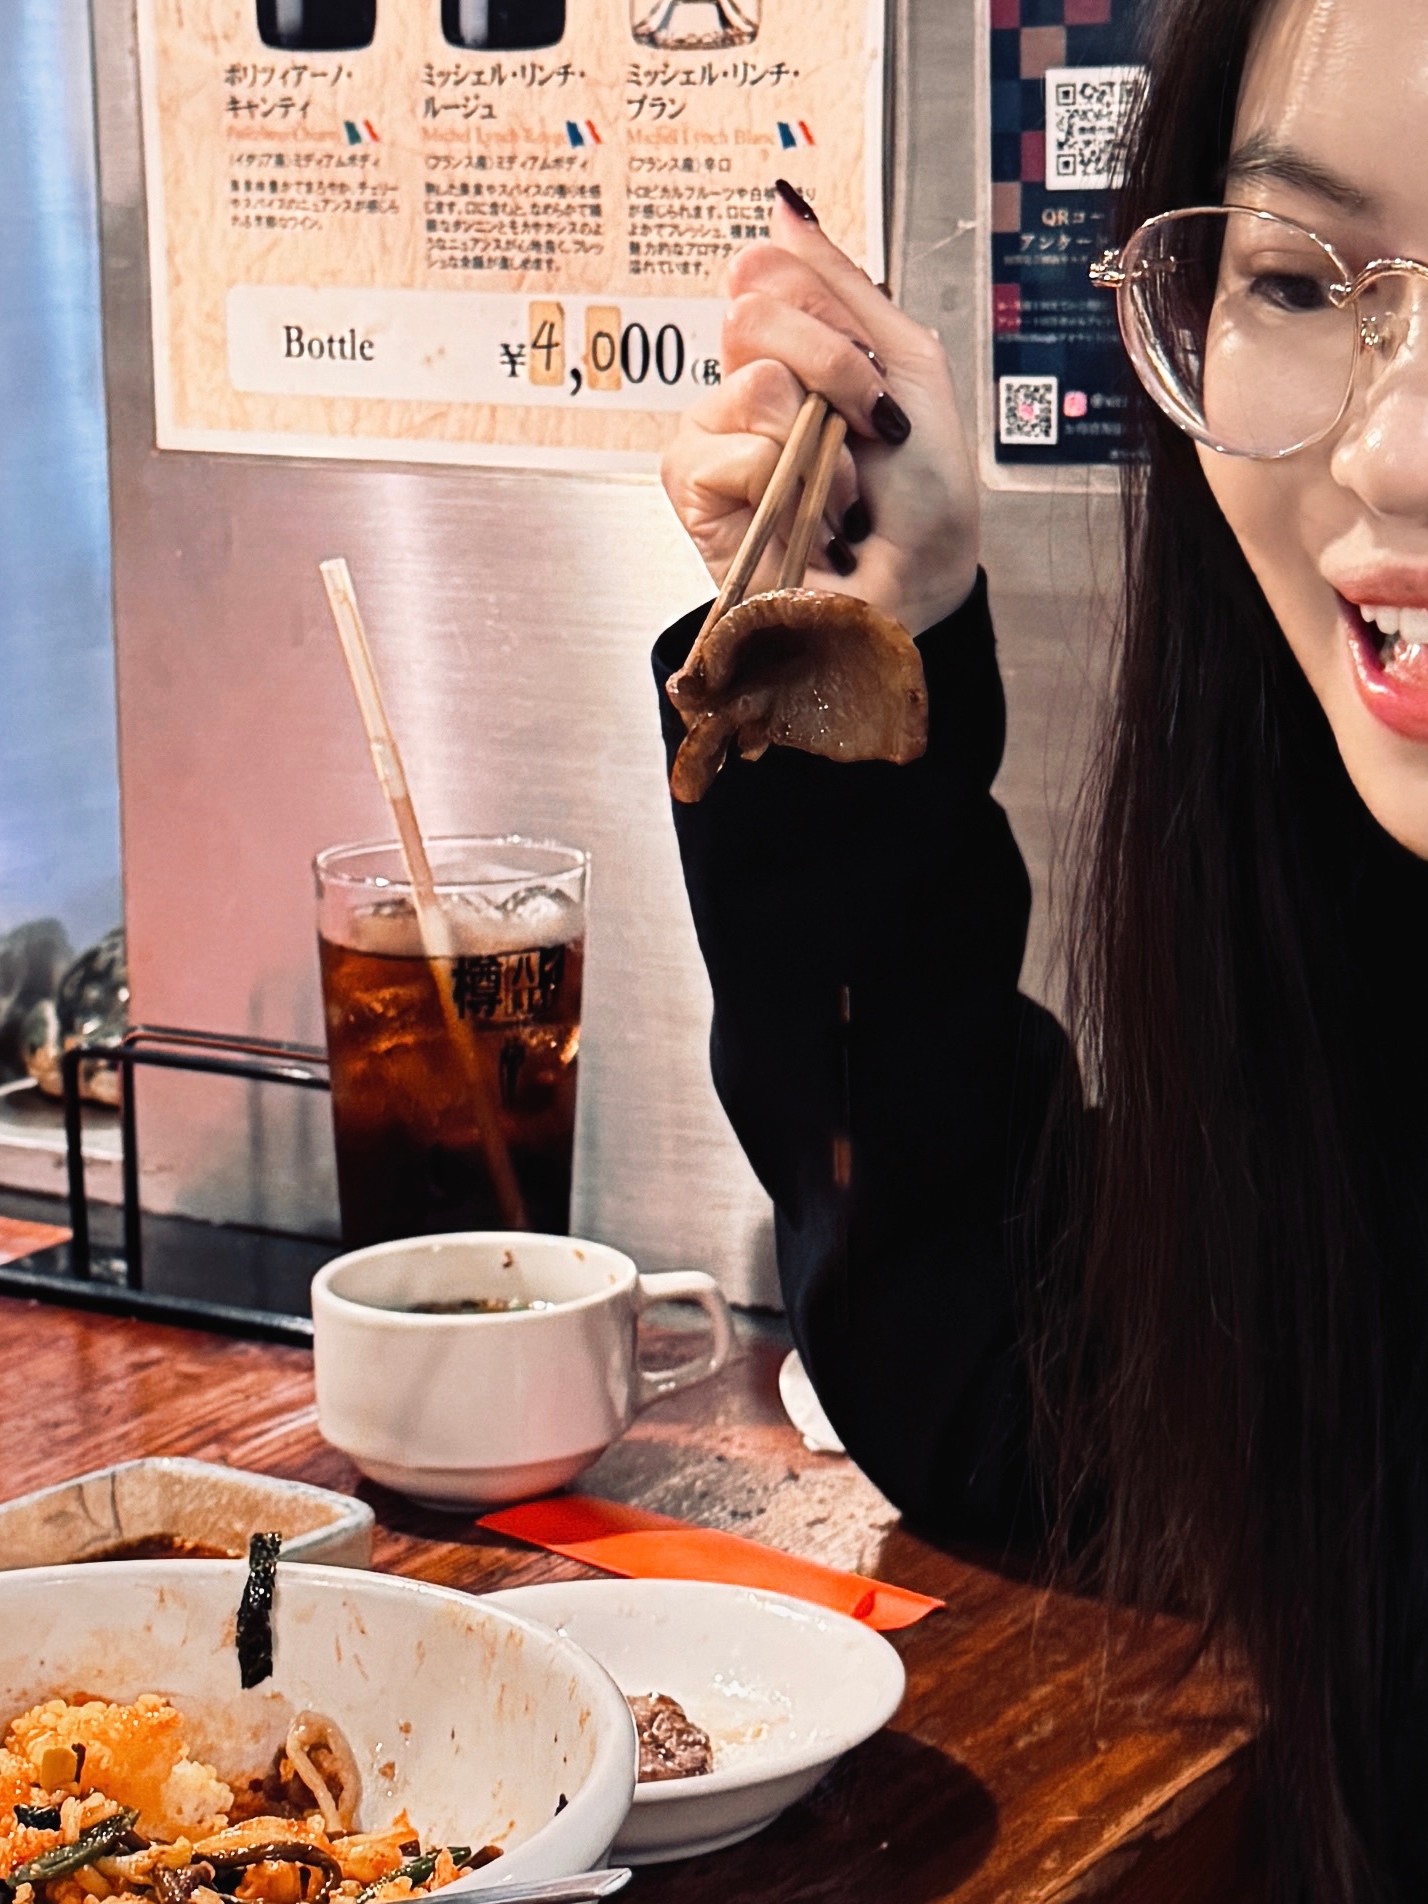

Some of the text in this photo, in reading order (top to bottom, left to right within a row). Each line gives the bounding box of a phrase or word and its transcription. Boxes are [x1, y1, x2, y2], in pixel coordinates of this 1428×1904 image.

[226, 95, 312, 120] キャンティ
[423, 94, 498, 120] ルージュ
[626, 94, 688, 122] ブラン
[283, 324, 375, 362] Bottle
[499, 319, 685, 397] ¥4,000
